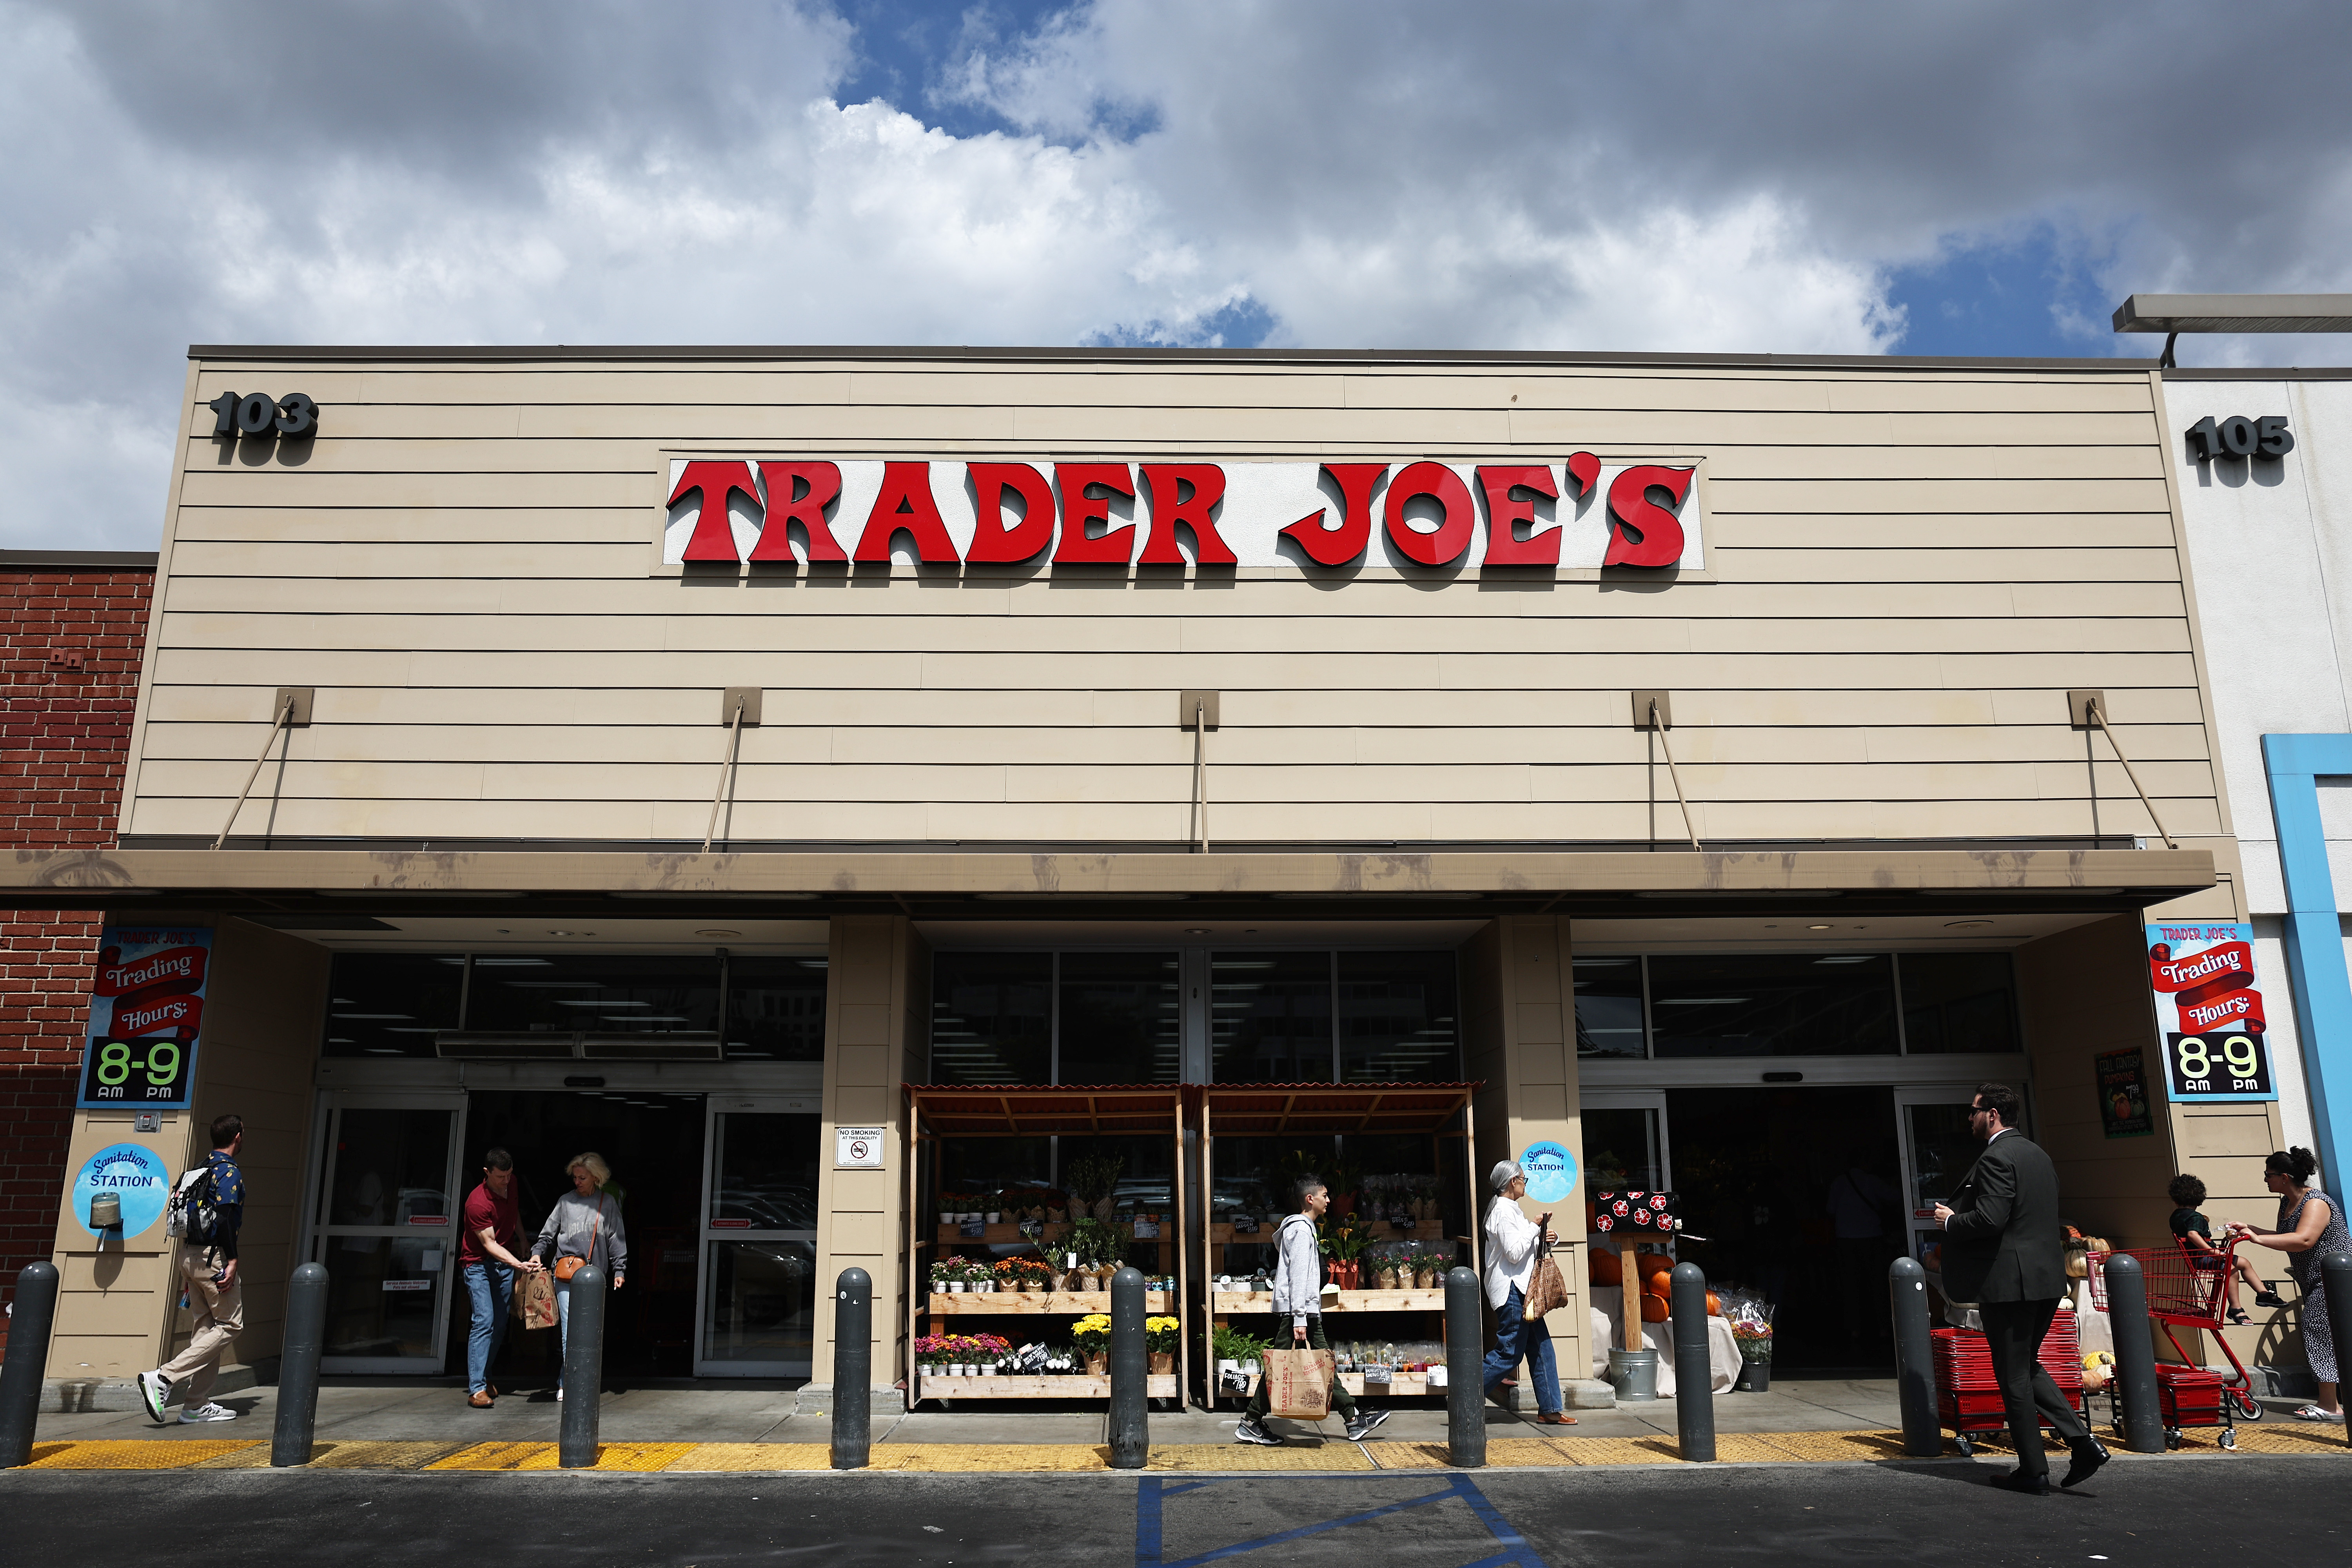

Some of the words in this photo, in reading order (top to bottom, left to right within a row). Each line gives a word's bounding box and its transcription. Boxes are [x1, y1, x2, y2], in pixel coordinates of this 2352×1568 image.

[210, 392, 318, 438] 103
[2185, 416, 2294, 459] 105
[666, 461, 1238, 564] TRADER
[1278, 451, 1695, 568] JOE'S
[117, 931, 160, 944] TRADER
[163, 932, 196, 944] JOE'S
[2160, 927, 2201, 941] TRADER
[2205, 927, 2238, 940] JOE'S
[106, 956, 193, 988] Trading
[2160, 951, 2241, 984] Trading
[122, 1002, 188, 1031] Hours:
[2189, 996, 2250, 1026] Hours:
[98, 1042, 180, 1085] 8-9
[2099, 1058, 2114, 1073] FALL
[2116, 1054, 2140, 1070] FANTASY
[2178, 1036, 2258, 1078] 8-9
[2104, 1071, 2135, 1085] PUMPKINS
[2185, 1080, 2211, 1091] AM
[2232, 1079, 2258, 1091] PM
[98, 1086, 123, 1098] AM
[146, 1087, 172, 1098] PM
[94, 1150, 148, 1174] Sanitation
[1528, 1147, 1564, 1162] Sanitation
[90, 1175, 152, 1187] STATION
[1303, 1358, 1322, 1370] REUSABLE
[1303, 1362, 1326, 1376] RECYCLABLE
